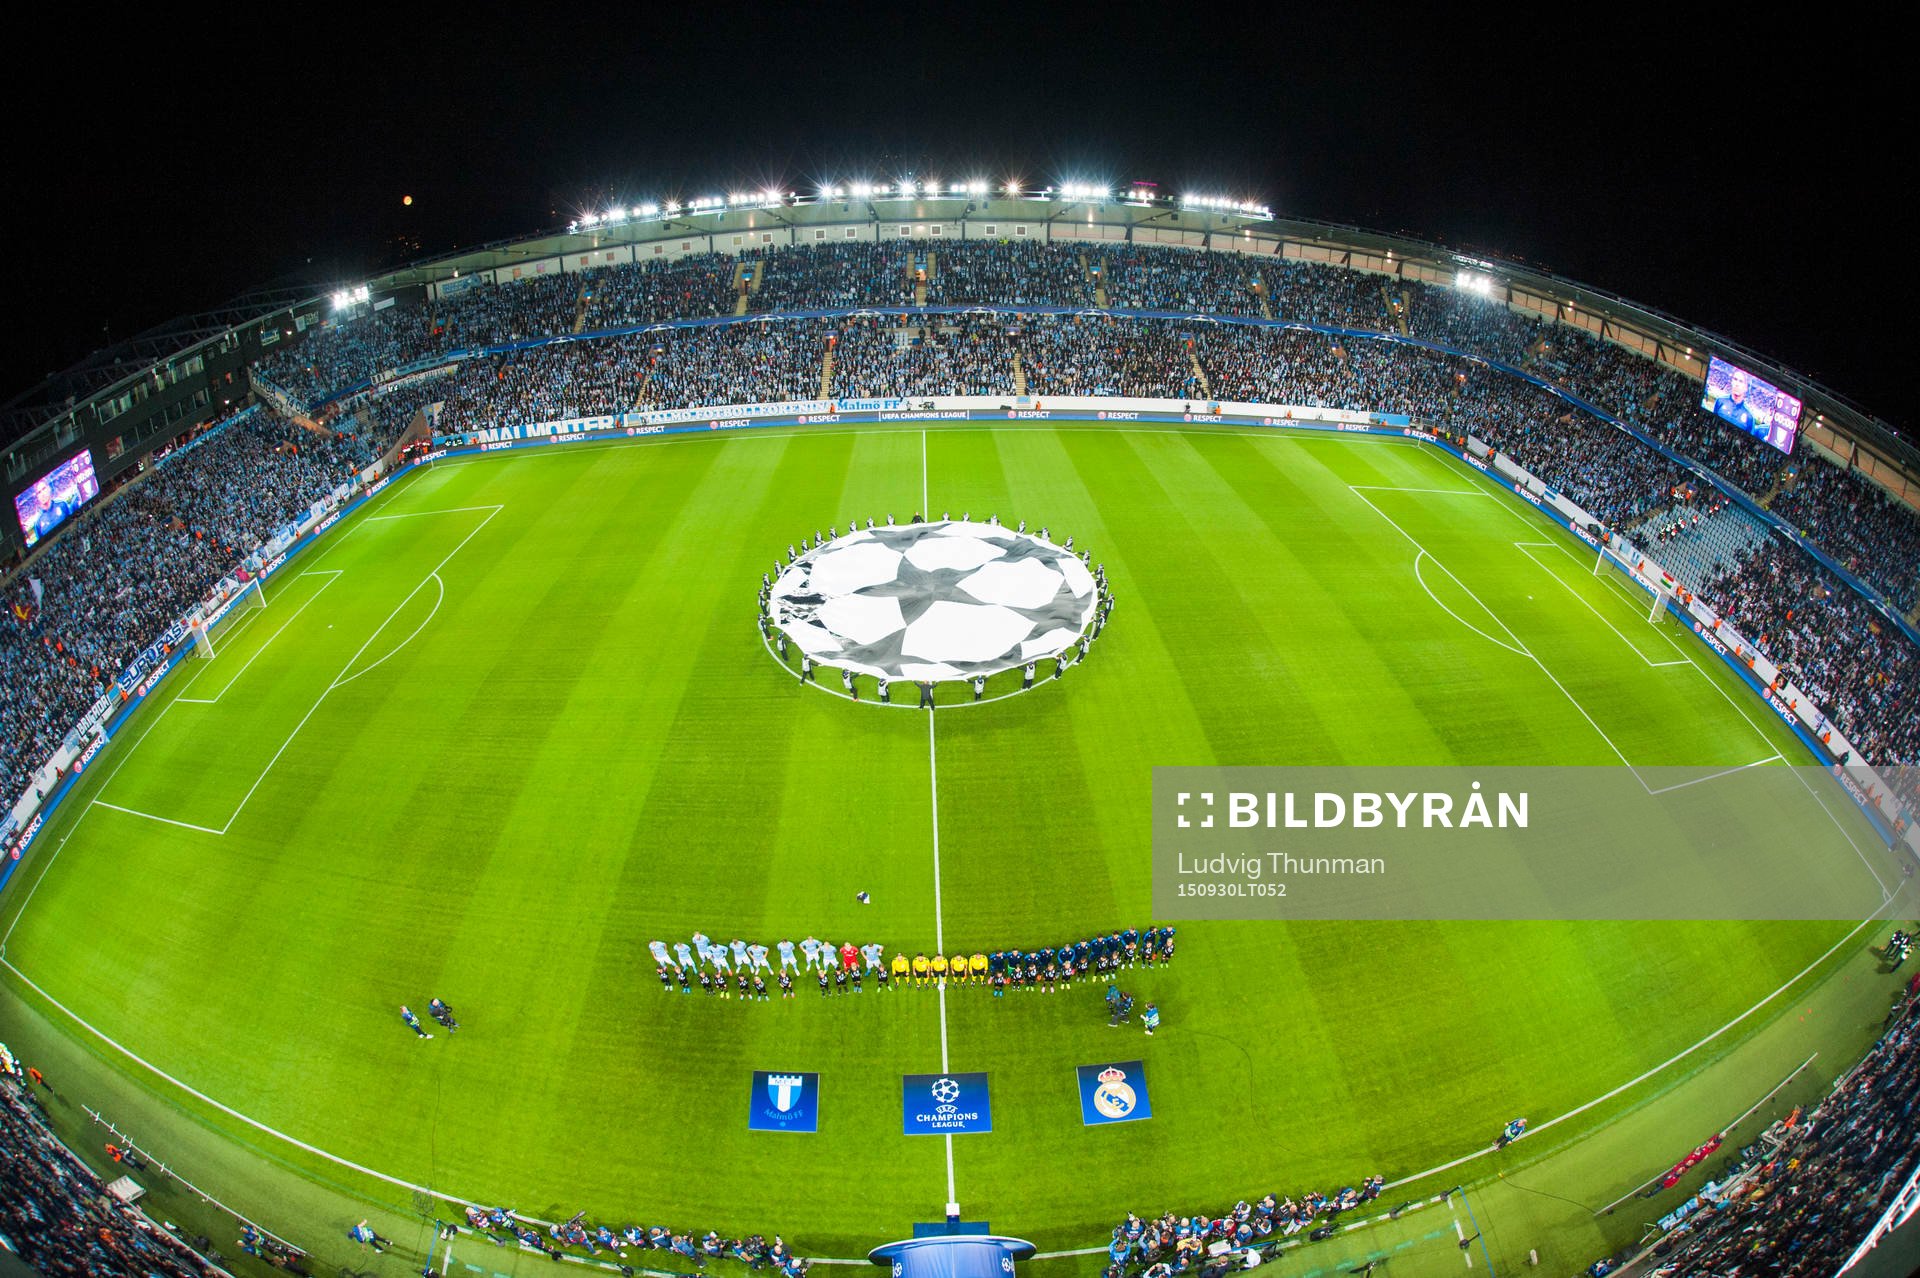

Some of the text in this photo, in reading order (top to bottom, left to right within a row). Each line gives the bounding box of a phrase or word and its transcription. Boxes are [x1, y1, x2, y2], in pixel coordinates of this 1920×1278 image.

[837, 399, 901, 411] Malmö FF
[809, 414, 841, 424] RESPECT
[881, 411, 967, 420] UEFA CHAMPIONS LEAGUE
[1018, 411, 1050, 419] RESPECT
[1107, 412, 1139, 420] RESPECT
[1193, 414, 1222, 423] RESPECT
[720, 419, 751, 429] RESPECT
[1272, 418, 1300, 427] RESPECT
[1345, 423, 1370, 432] RESPECT
[636, 425, 665, 435] RESPECT
[558, 433, 585, 442] RESPECT
[1412, 430, 1438, 443] RESPECT
[488, 441, 513, 450] RESPECT
[1468, 456, 1488, 472] RESPECT
[372, 476, 390, 494] RESPECT
[1520, 487, 1542, 506] RESPECT
[320, 511, 341, 530] RESPECT
[1575, 527, 1599, 547] RESPECT
[266, 552, 288, 573] RESPECT
[1700, 628, 1728, 656] RESPECT
[145, 659, 170, 688] RESPECT
[1770, 696, 1798, 726] RESPECT
[81, 735, 105, 765] RESPEC
[1840, 774, 1868, 807] RESPECT
[18, 813, 43, 850] RESPECT
[916, 1112, 978, 1122] CHAMPIONS
[932, 1121, 963, 1129] LEAGUE
